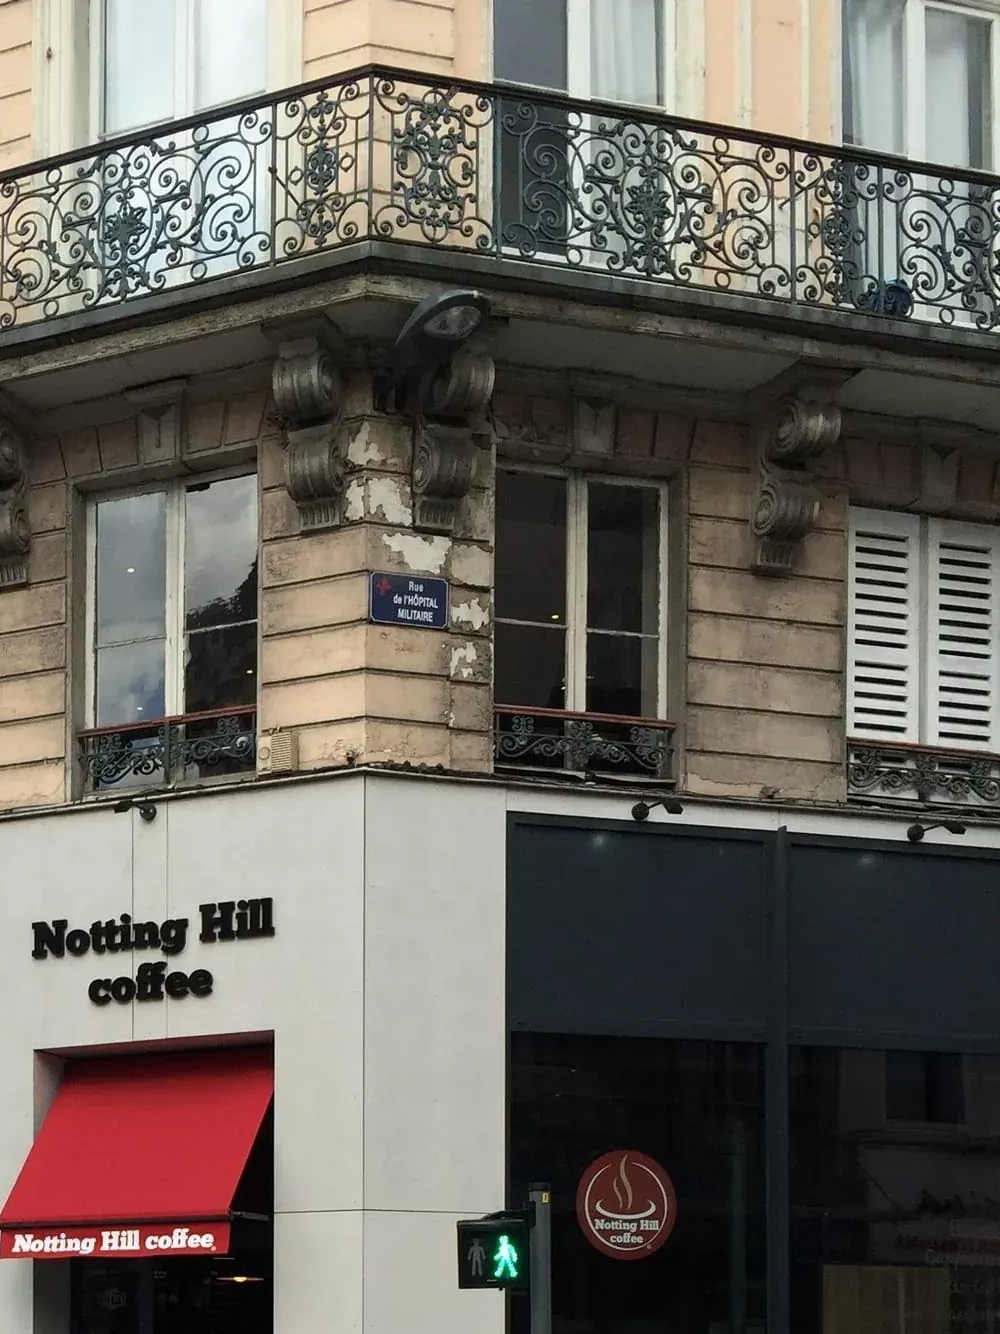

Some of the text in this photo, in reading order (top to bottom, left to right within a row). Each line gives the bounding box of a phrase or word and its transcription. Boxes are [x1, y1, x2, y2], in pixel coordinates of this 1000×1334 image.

[409, 581, 422, 592] Rue
[393, 594, 402, 604] de
[397, 608, 433, 622] MILITAIRE
[31, 897, 276, 960] Notting Hill
[88, 961, 214, 1006] coffee
[595, 1219, 660, 1232] Notting Hill
[12, 1228, 215, 1254] Notting Hill coffee
[610, 1232, 644, 1244] coffee
